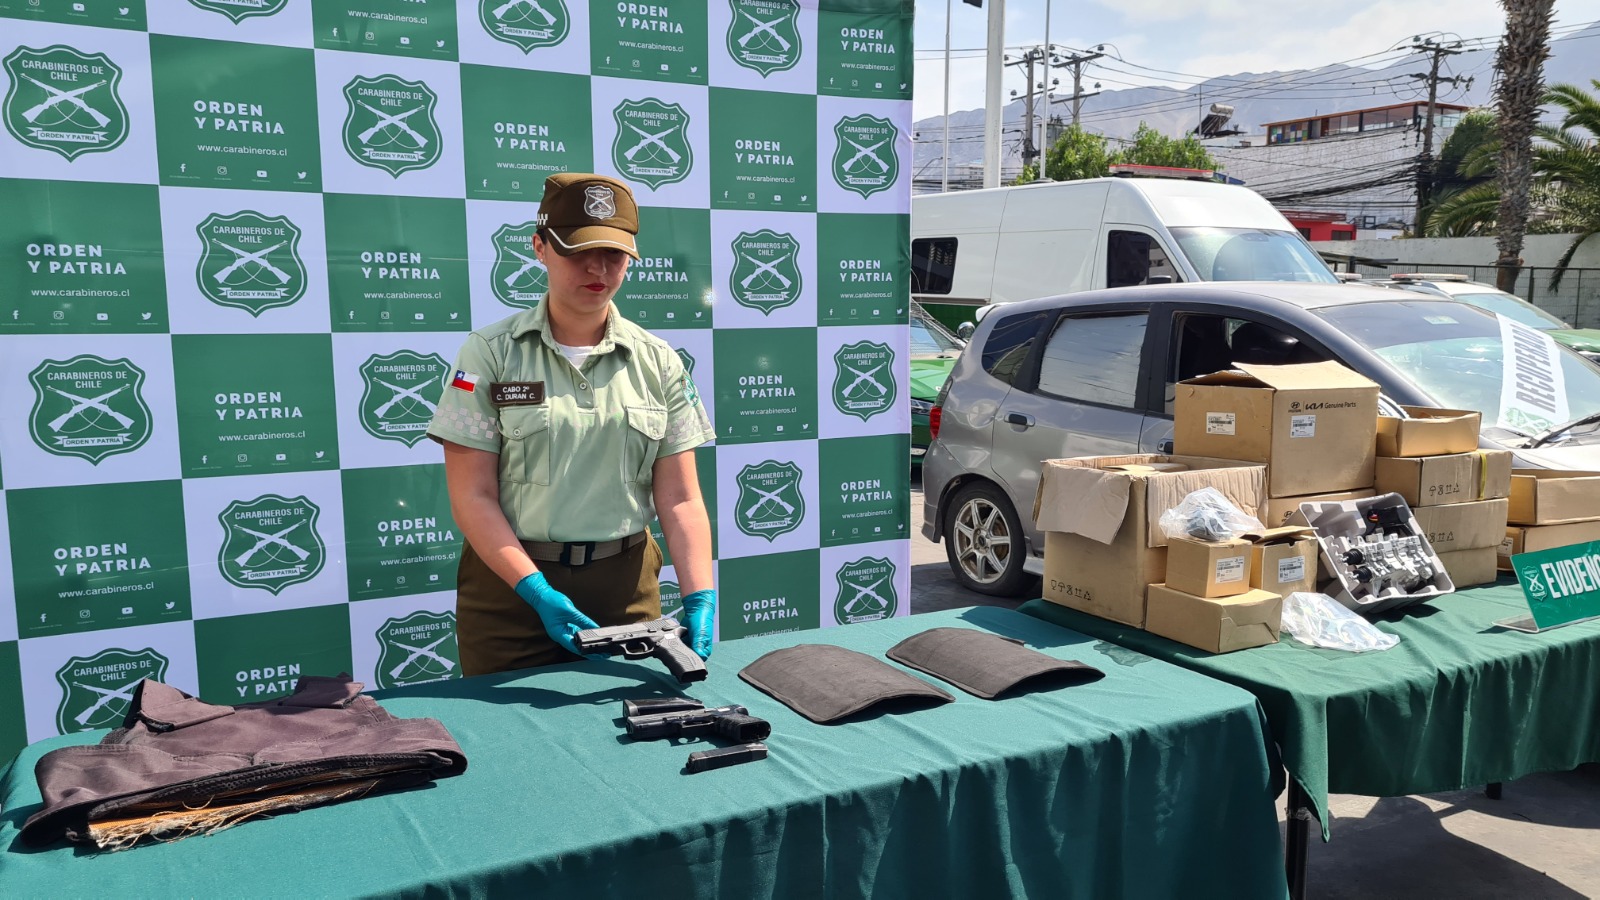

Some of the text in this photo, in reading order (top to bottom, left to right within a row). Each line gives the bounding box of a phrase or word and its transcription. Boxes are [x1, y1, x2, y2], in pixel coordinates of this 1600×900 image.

[618, 2, 667, 18] ORDEN
[348, 9, 427, 25] www.carabineros.cl
[618, 16, 683, 34] Y PATRIA
[841, 27, 883, 40] ORDEN
[619, 39, 684, 53] www.carabineros.cl
[841, 40, 895, 55] Y PATRIA
[22, 59, 104, 74] CARABINEROS DE
[51, 71, 78, 82] CHILE
[358, 88, 411, 100] CARABINEROS
[193, 100, 263, 117] ORDEN
[380, 98, 402, 107] CHILE
[625, 110, 668, 120] CARABINEROS
[194, 116, 285, 134] Y PATRIA
[494, 122, 548, 137] ORDEN
[844, 126, 880, 134] CARABINEROS
[197, 143, 287, 156] www.carabineros.cl
[494, 137, 565, 152] Y PATRIA
[735, 139, 780, 152] ORDEN
[736, 153, 794, 166] Y PATRIA
[496, 161, 567, 172] www.carabineros.cl
[213, 226, 272, 235] CARABINEROS
[504, 235, 532, 243] CARABIN
[26, 244, 102, 258] ORDEN
[361, 252, 421, 264] ORDEN
[840, 259, 880, 269] ORDEN
[28, 261, 126, 274] Y PATRIA
[362, 267, 440, 279] Y PATRIA
[625, 272, 688, 282] Y PATRIA
[840, 272, 892, 282] Y PATRIA
[31, 288, 129, 297] www.carabineros.cl
[374, 364, 425, 373] CARABINEROS
[47, 371, 113, 381] CARABINEROS
[739, 375, 782, 386] ORDEN
[75, 381, 102, 389] CHILE
[215, 392, 282, 405] ORDEN
[739, 387, 796, 399] Y PATRIA
[216, 406, 303, 421] Y PATRIA
[219, 431, 305, 442] www.carabineros.cl
[747, 472, 783, 481] CARABINEROS
[842, 479, 880, 491] ORDEN
[842, 490, 892, 504] Y PATRIA
[235, 508, 292, 520] CARABINEROS
[259, 517, 282, 526] CHILE
[377, 517, 435, 532] ORDEN
[378, 530, 454, 547] Y PATRIA
[54, 542, 128, 560] ORDEN
[380, 552, 456, 566] www.carabineros.cl
[55, 556, 152, 576] Y PATRIA
[58, 582, 154, 598] www.carabineros.cl
[743, 596, 785, 612] ORDEN
[743, 607, 798, 624] Y PATRIA
[390, 623, 440, 636] CARABINEROS
[411, 631, 431, 640] CHILE
[74, 660, 151, 677] CARABINEROS DE
[236, 663, 300, 683] ORDEN
[101, 671, 127, 682] CHILE
[237, 679, 298, 698] Y PATR
